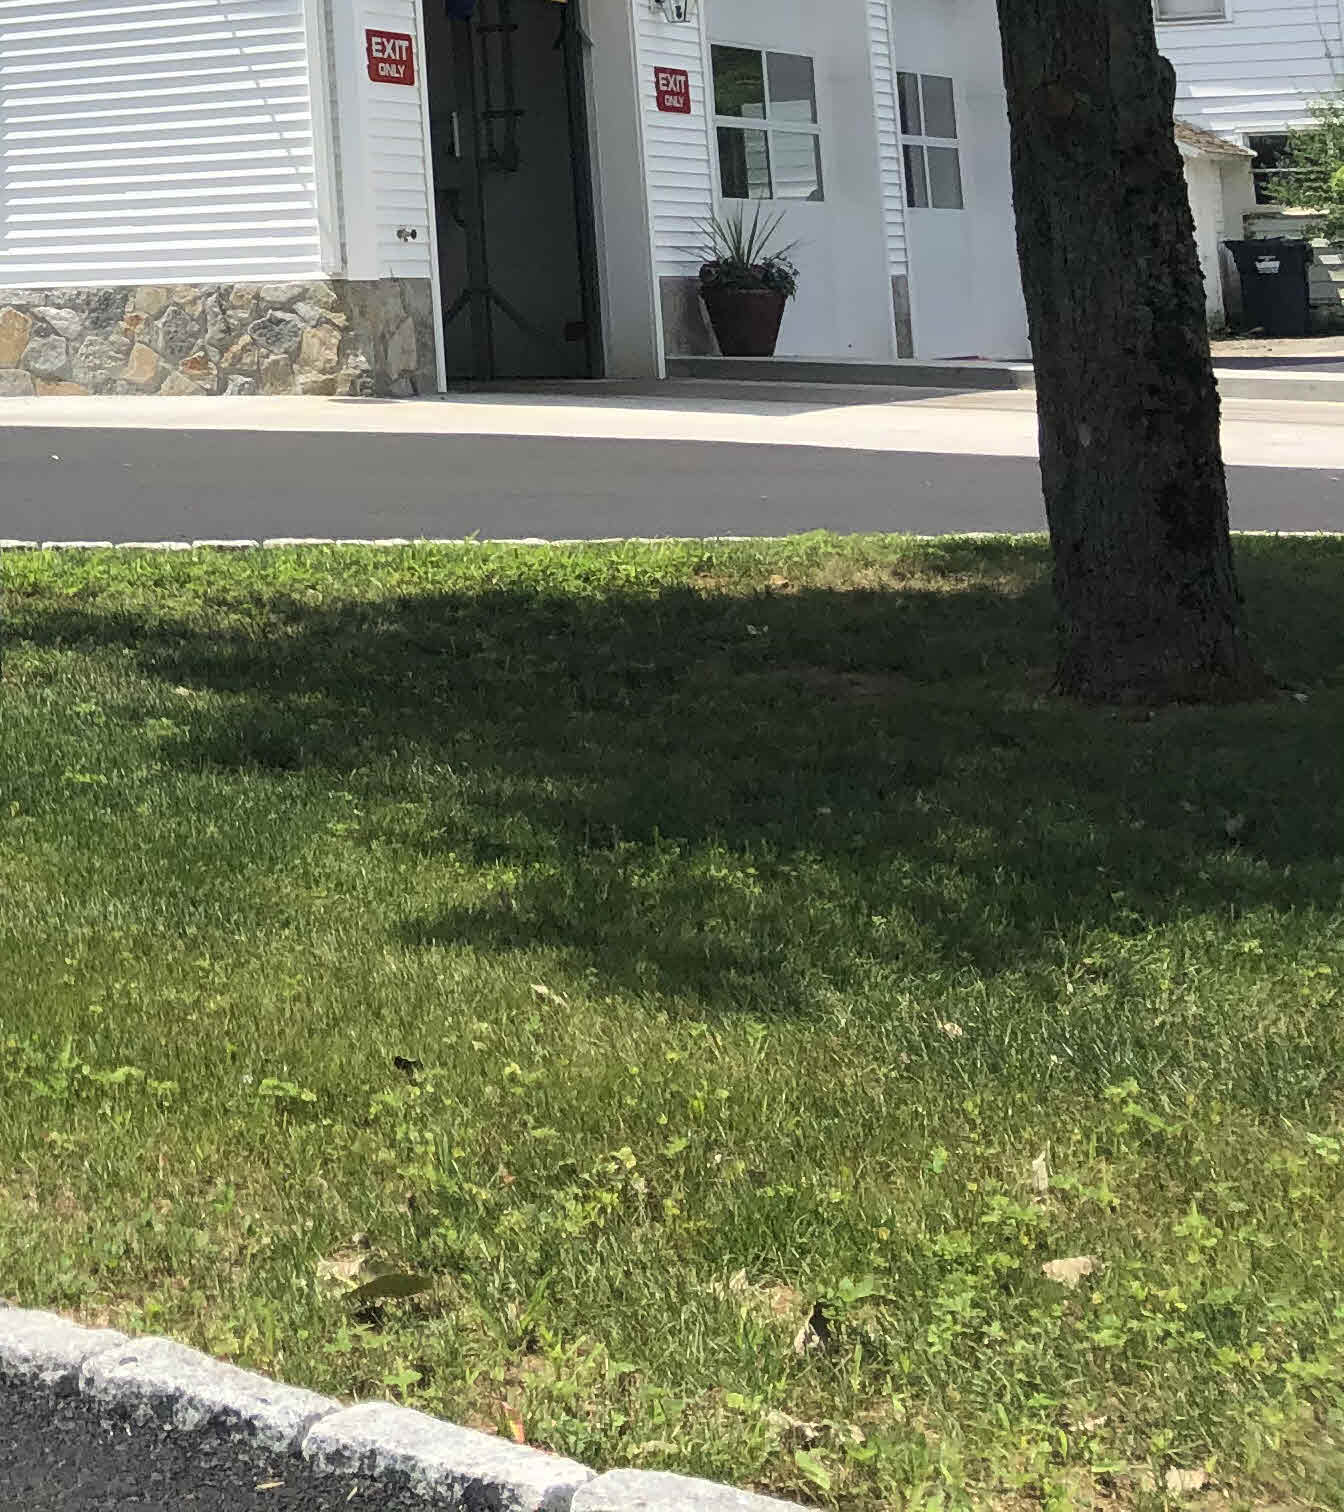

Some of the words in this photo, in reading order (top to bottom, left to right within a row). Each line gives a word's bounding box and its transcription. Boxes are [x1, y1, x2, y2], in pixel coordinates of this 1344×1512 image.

[372, 36, 409, 61] EXIT
[378, 62, 406, 78] ONLY
[658, 72, 686, 93] EXIT
[664, 94, 684, 108] ONLY
